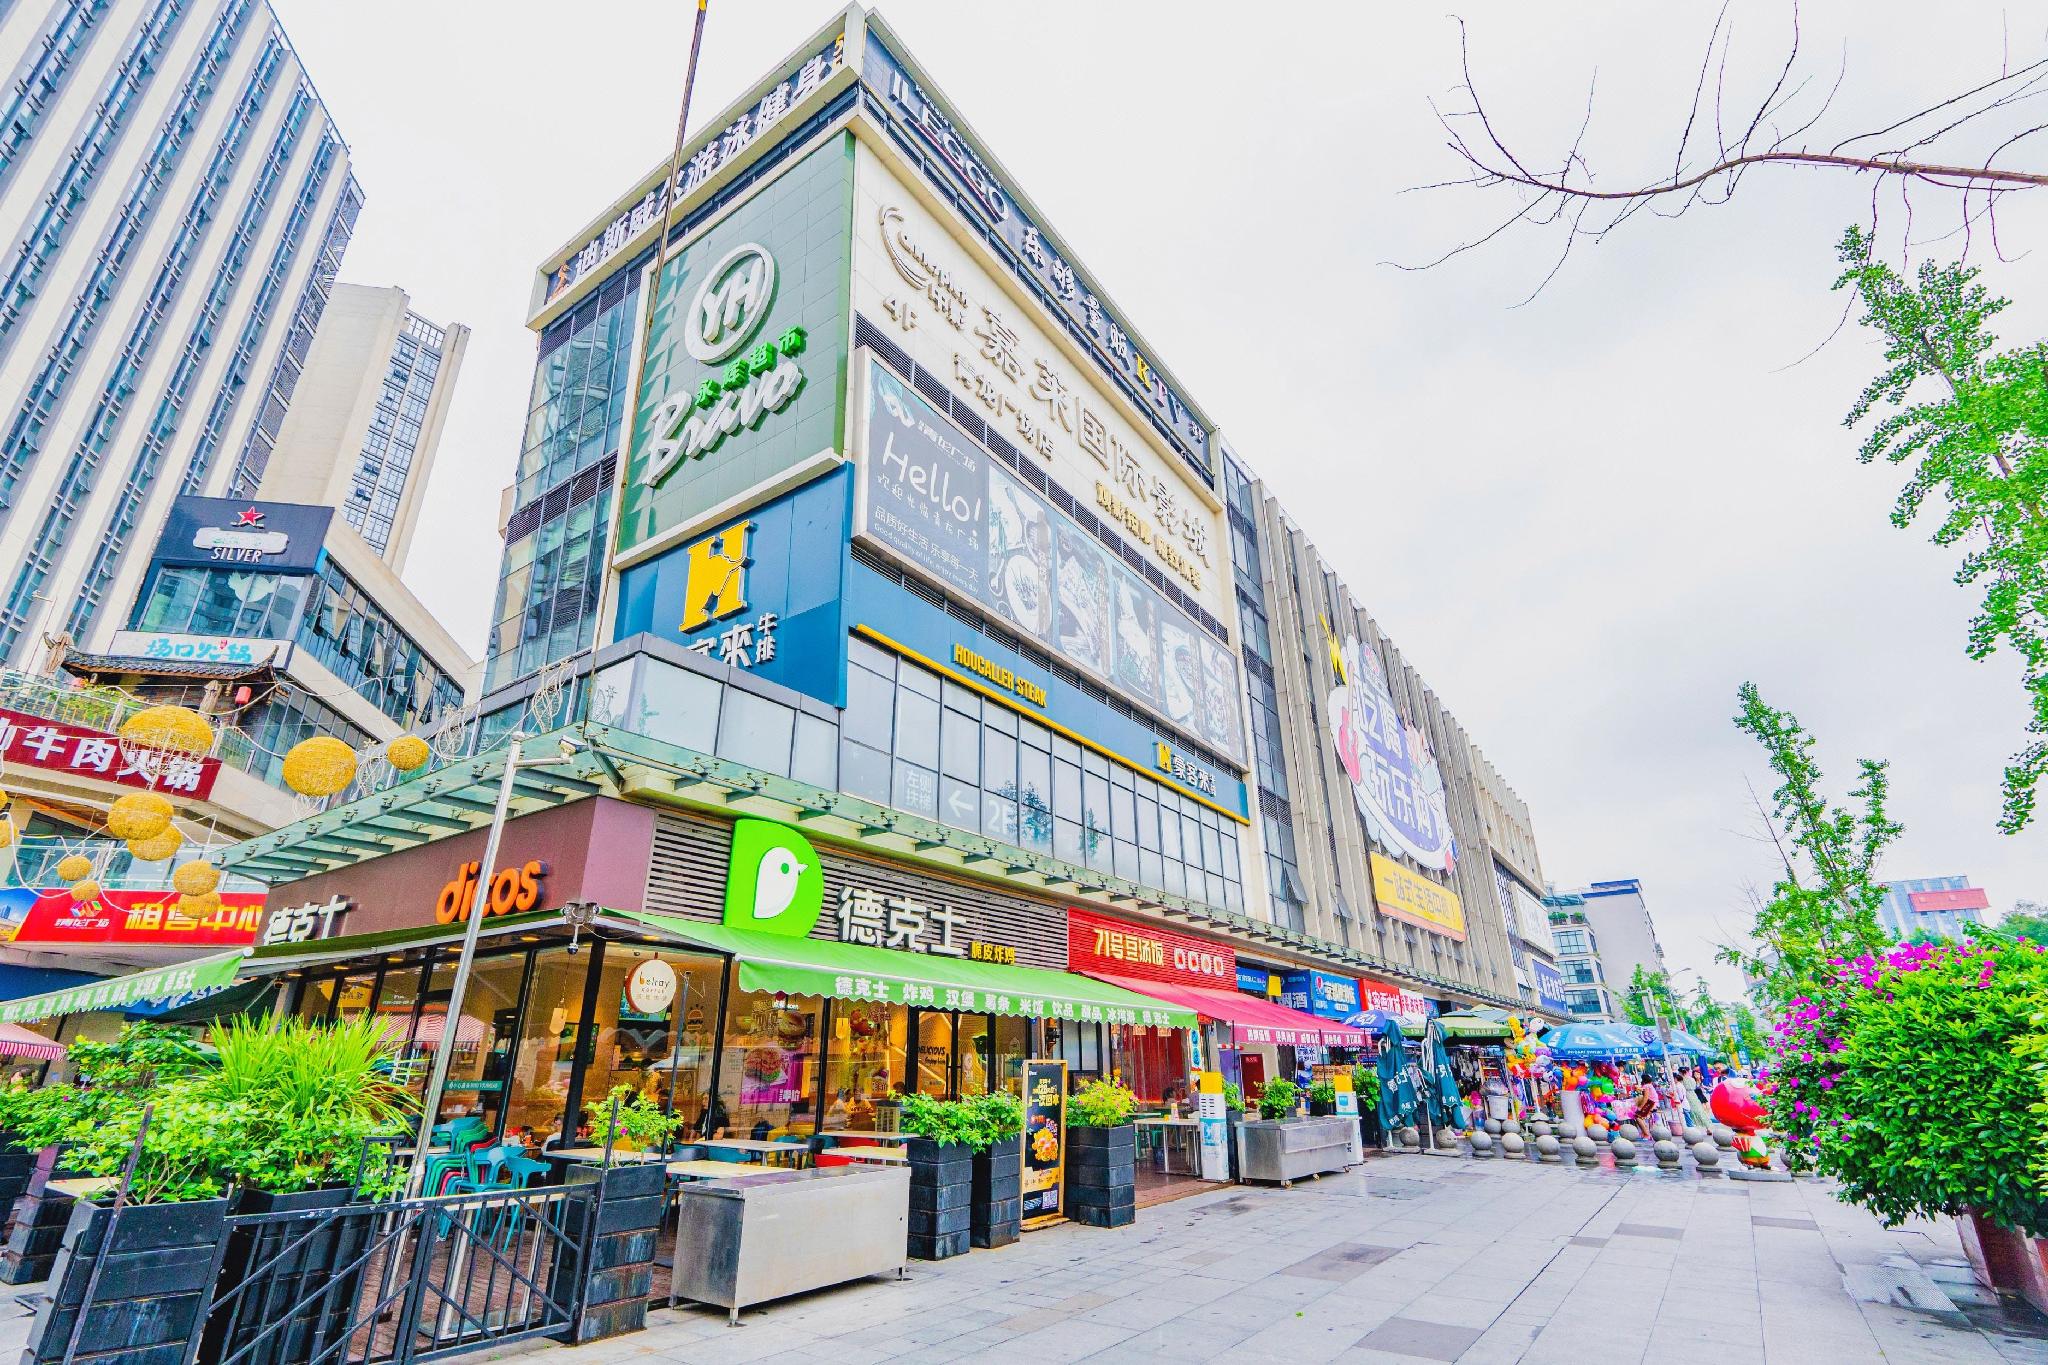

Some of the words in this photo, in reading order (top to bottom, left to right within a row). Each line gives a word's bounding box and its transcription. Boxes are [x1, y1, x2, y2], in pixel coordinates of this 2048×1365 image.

[883, 431, 981, 538] Hello!
[211, 547, 262, 563] SILVER
[955, 643, 1015, 690] HOUCALLER
[1016, 676, 1047, 708] STEAK
[907, 767, 932, 794] 左侧
[125, 902, 263, 932] 租售中心
[263, 893, 350, 945] 德克士
[839, 885, 967, 957] 德克士
[971, 940, 1015, 965] 脆皮炸鸡
[1093, 928, 1164, 966] 71号豆汤饭
[836, 976, 890, 999] 德克士
[903, 983, 934, 1002] 炸鸡
[946, 989, 974, 1007] 汉堡
[1142, 1010, 1170, 1025] 德克士
